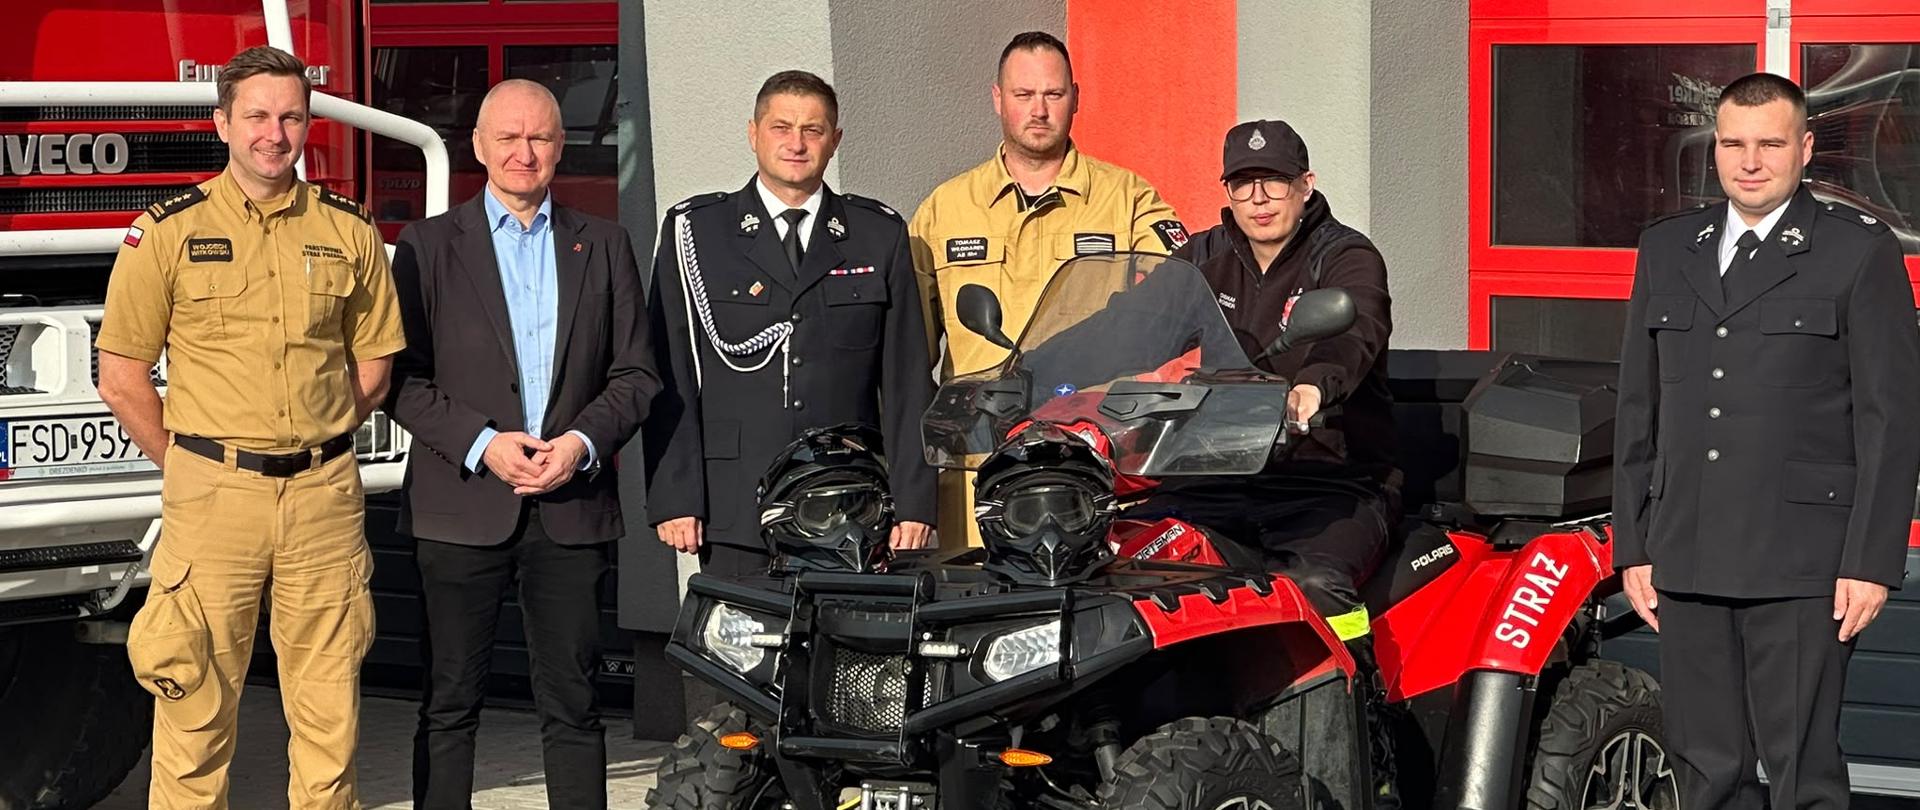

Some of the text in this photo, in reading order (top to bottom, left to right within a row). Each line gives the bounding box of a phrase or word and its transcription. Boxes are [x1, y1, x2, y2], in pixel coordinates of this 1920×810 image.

[0, 133, 129, 175] VECO
[12, 421, 144, 465] FSD 9599
[1134, 524, 1186, 561] ORTSMAN
[1410, 543, 1455, 571] POLARIS
[1495, 551, 1569, 649] STRAŻ
